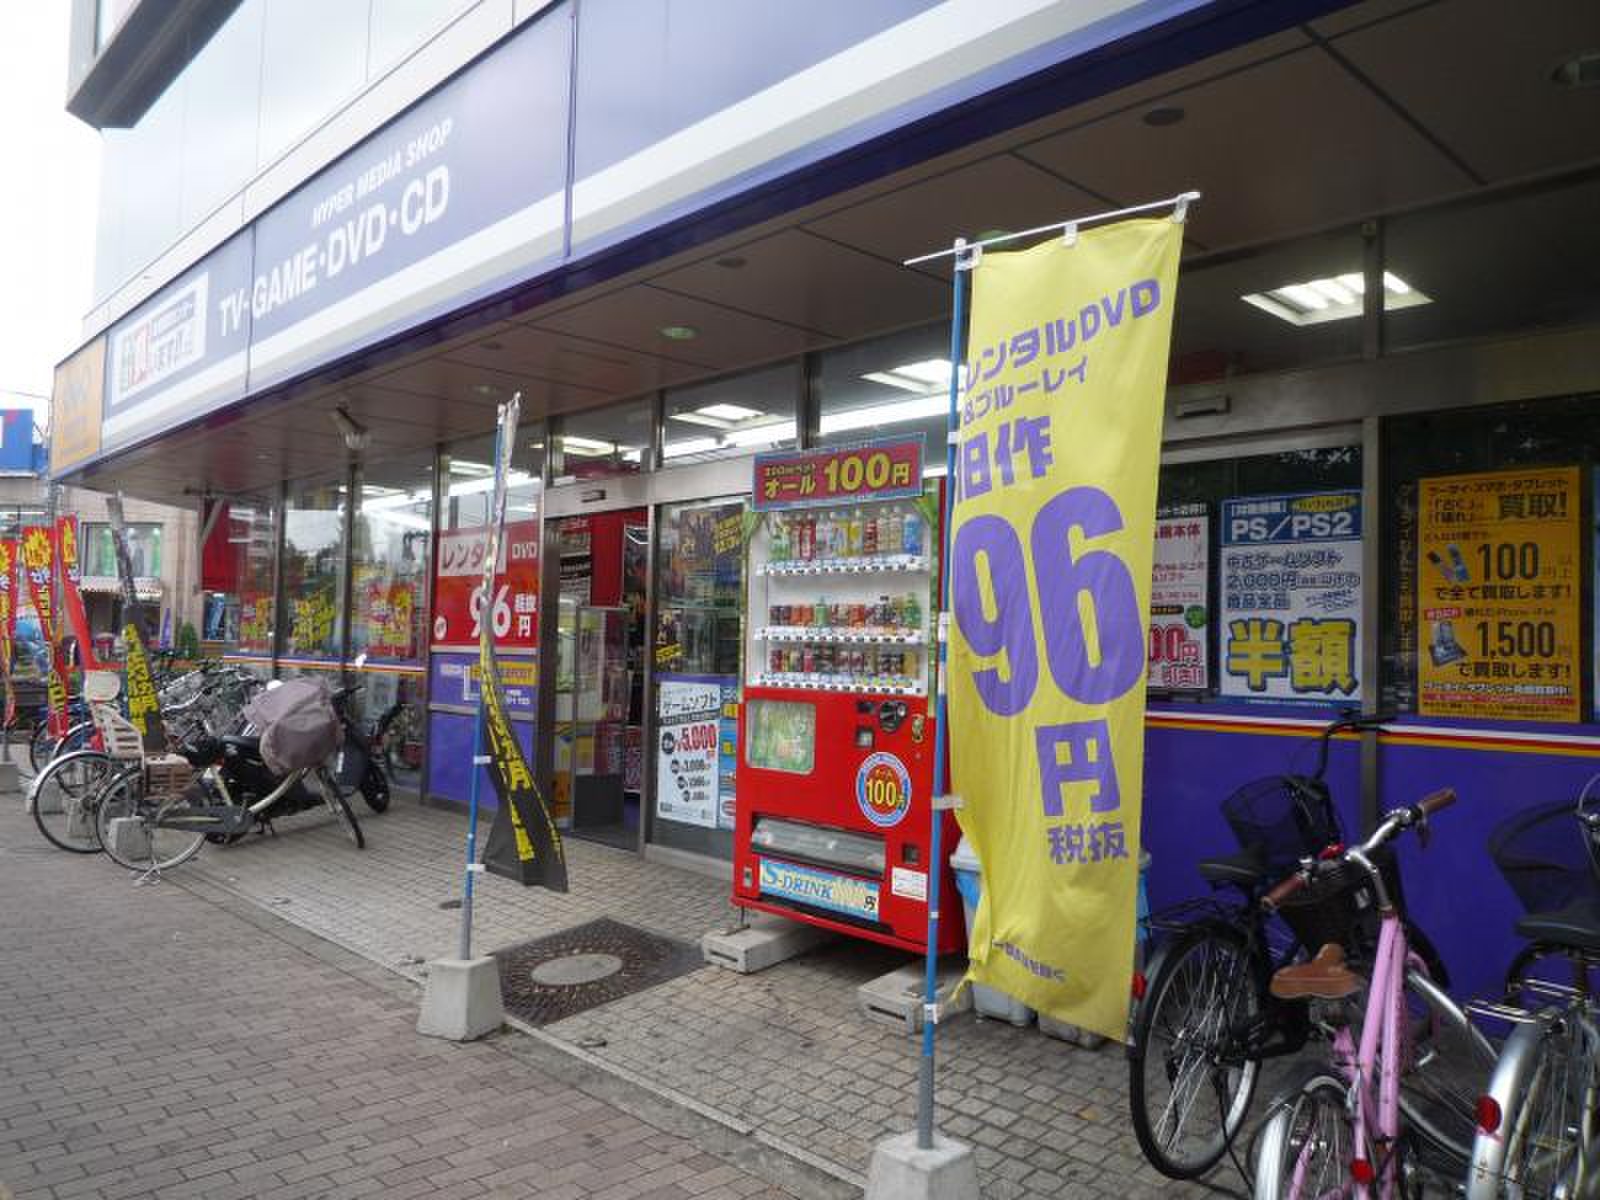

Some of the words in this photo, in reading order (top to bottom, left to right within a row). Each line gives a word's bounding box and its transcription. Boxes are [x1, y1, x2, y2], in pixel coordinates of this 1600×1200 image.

[356, 151, 401, 200] MEDIA
[405, 118, 453, 167] SHOP
[764, 478, 817, 500] オール
[823, 452, 911, 493] 100円
[1231, 511, 1354, 542] PS/PS2
[511, 543, 538, 560] DVD
[1477, 541, 1540, 581] 100
[951, 485, 1146, 717] 96
[1226, 617, 1359, 696] 半額
[1476, 621, 1556, 659] 1,500
[1034, 718, 1122, 817] 円
[1047, 821, 1129, 865] 税抜
